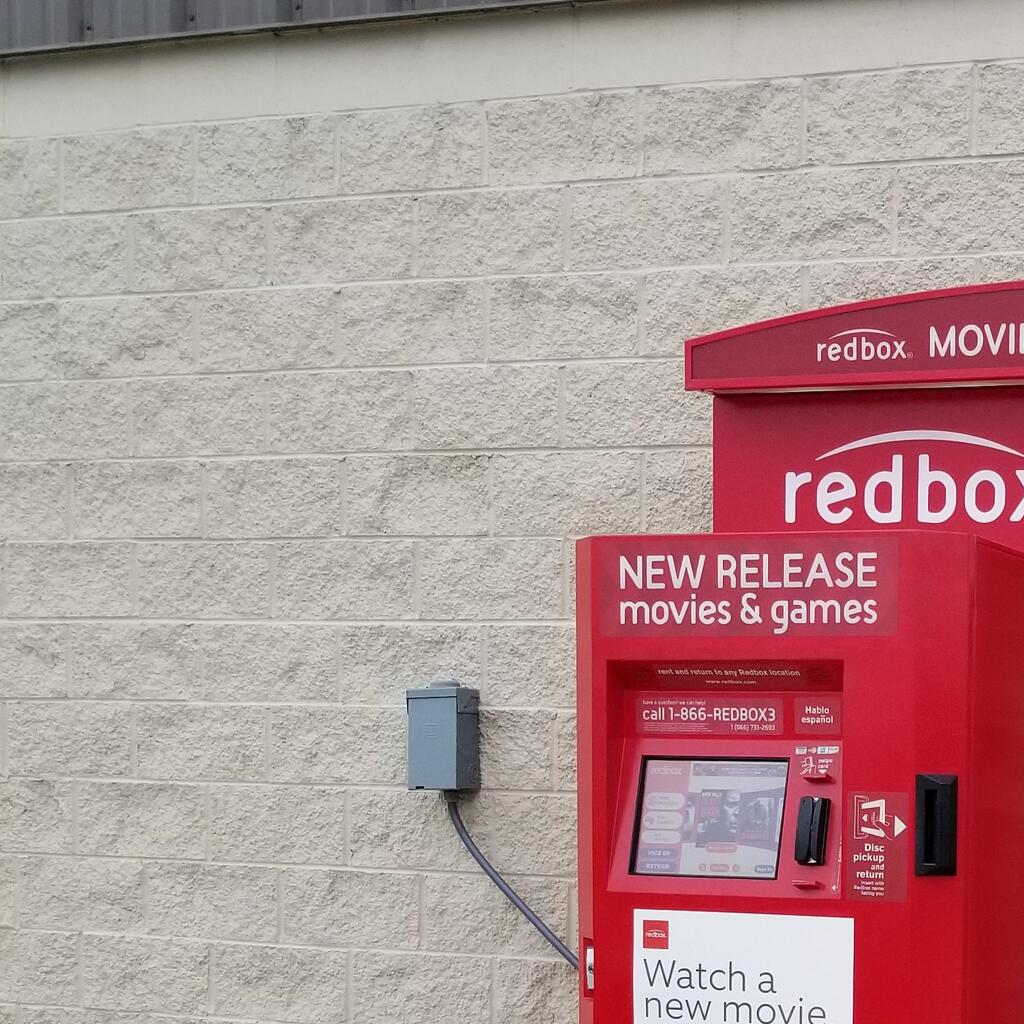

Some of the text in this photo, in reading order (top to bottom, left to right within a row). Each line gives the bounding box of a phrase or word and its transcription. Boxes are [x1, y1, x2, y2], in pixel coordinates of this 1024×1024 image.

[816, 336, 907, 362] redbox
[620, 552, 878, 590] NEW RELEASE
[620, 592, 878, 635] movies & games
[724, 670, 738, 678] any
[769, 669, 801, 677] location
[643, 707, 776, 721] call 1-866-REDBOX3
[805, 706, 829, 714] Hablo
[801, 715, 834, 725] español
[864, 843, 885, 853] Disc
[853, 853, 885, 863] pickup
[871, 863, 885, 871] and
[856, 871, 885, 880] return
[643, 958, 777, 993] Watch a
[645, 997, 711, 1021] new
